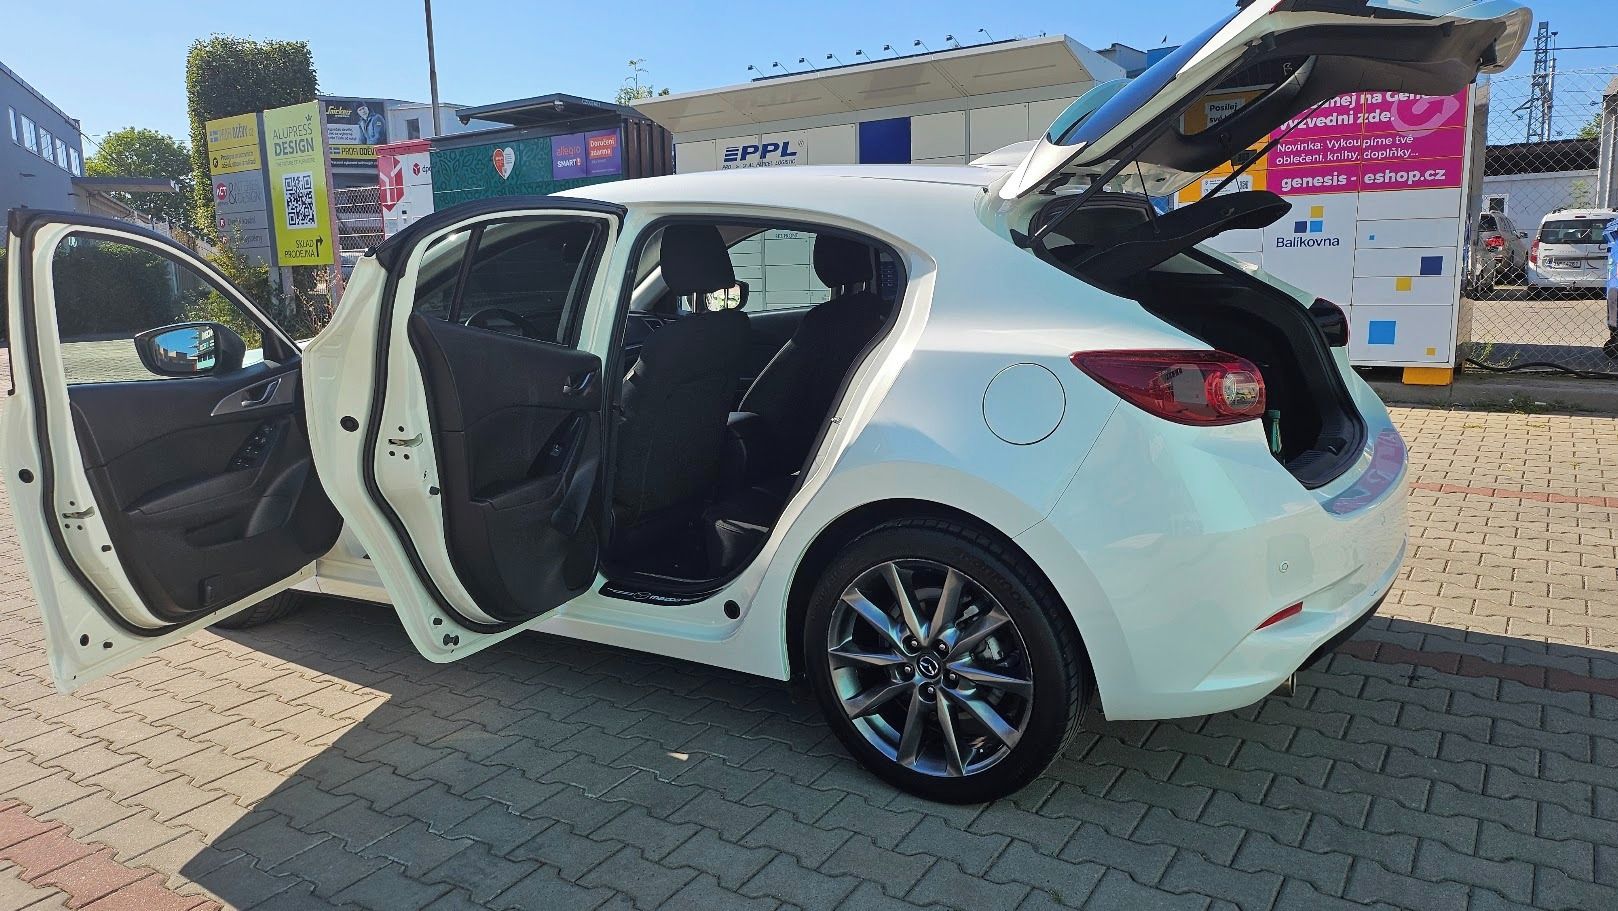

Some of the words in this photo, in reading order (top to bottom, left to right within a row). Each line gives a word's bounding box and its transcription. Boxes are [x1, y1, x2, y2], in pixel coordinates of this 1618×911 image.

[1360, 92, 1383, 104] na
[1357, 110, 1395, 124] zde.
[273, 122, 312, 140] ALUPRESS
[274, 137, 315, 157] DESIGN
[556, 145, 581, 157] allegro
[740, 140, 798, 161] PPL
[1277, 141, 1324, 153] Novinka:
[1396, 135, 1414, 144] tvé
[1281, 172, 1347, 191] genesis
[1364, 169, 1446, 185] eshop.cz
[295, 239, 314, 249] SKLAD
[1276, 236, 1340, 248] Balíkovna
[284, 249, 316, 259] PRODEJNA
